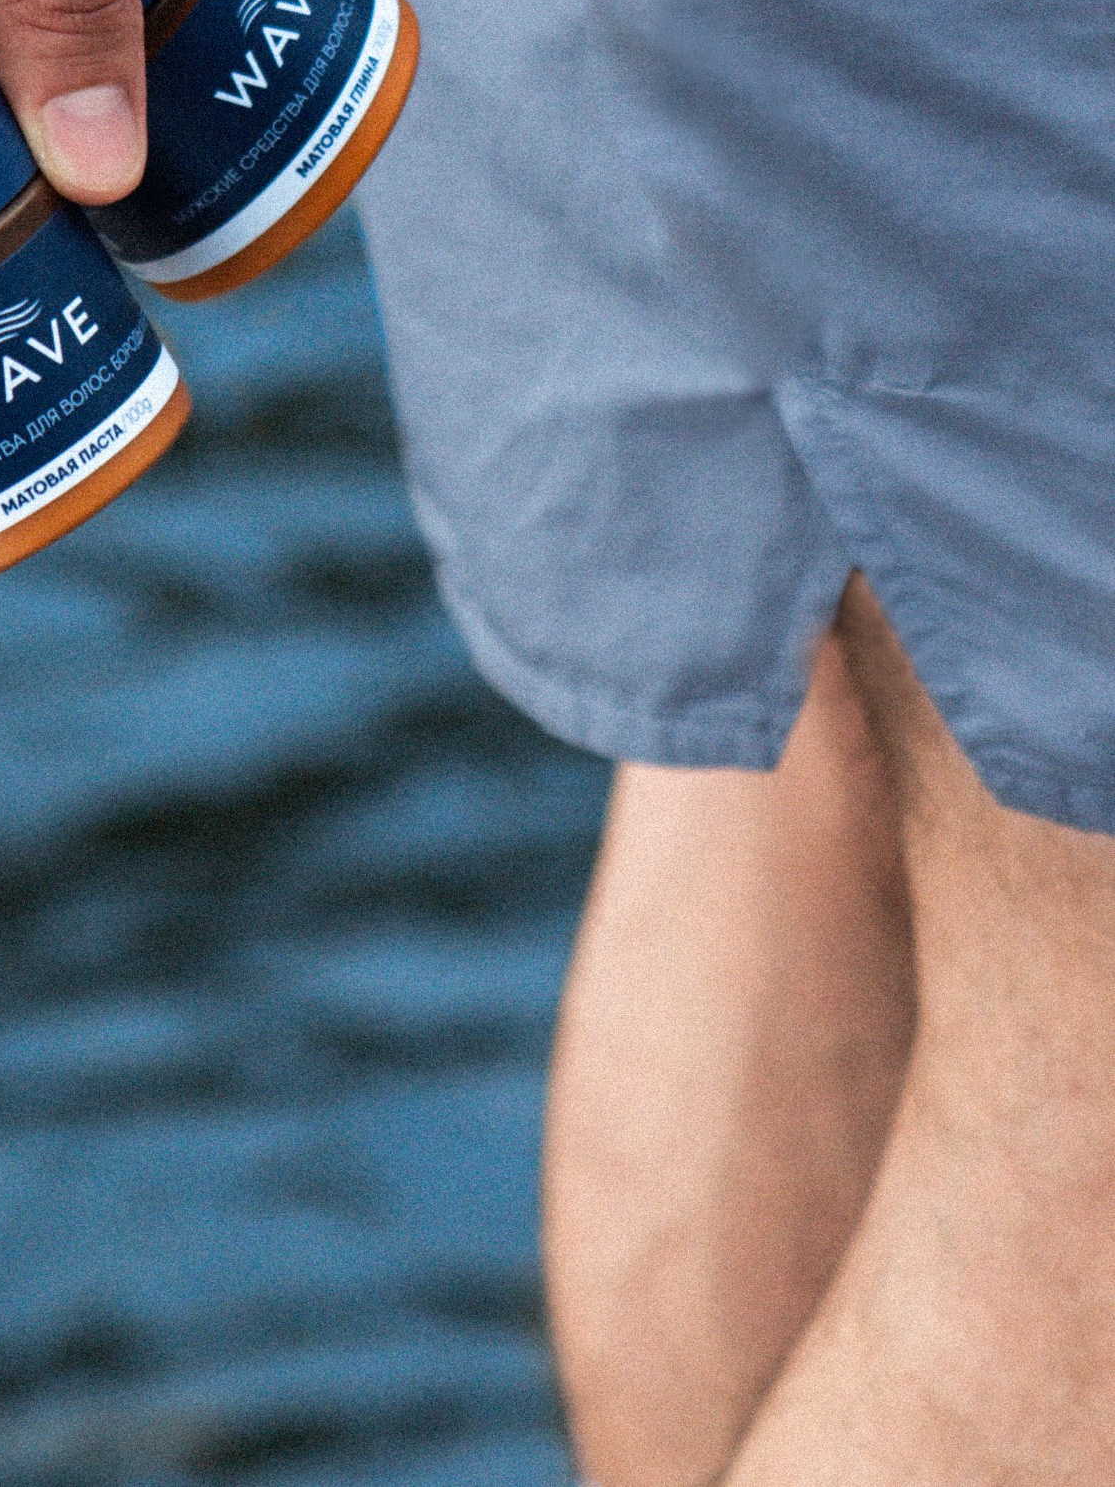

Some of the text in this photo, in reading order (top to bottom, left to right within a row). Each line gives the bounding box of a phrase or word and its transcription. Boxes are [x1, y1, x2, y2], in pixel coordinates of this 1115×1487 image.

[239, 93, 309, 171] СРЕДСТВА
[303, 58, 329, 96] ДЛЯ
[295, 55, 380, 178] МАТОВАЯ ГЛИНА
[0, 456, 80, 516] МАТОВАЯ
[80, 422, 124, 465] ПАСТА
[25, 407, 62, 444] ДЛЯ
